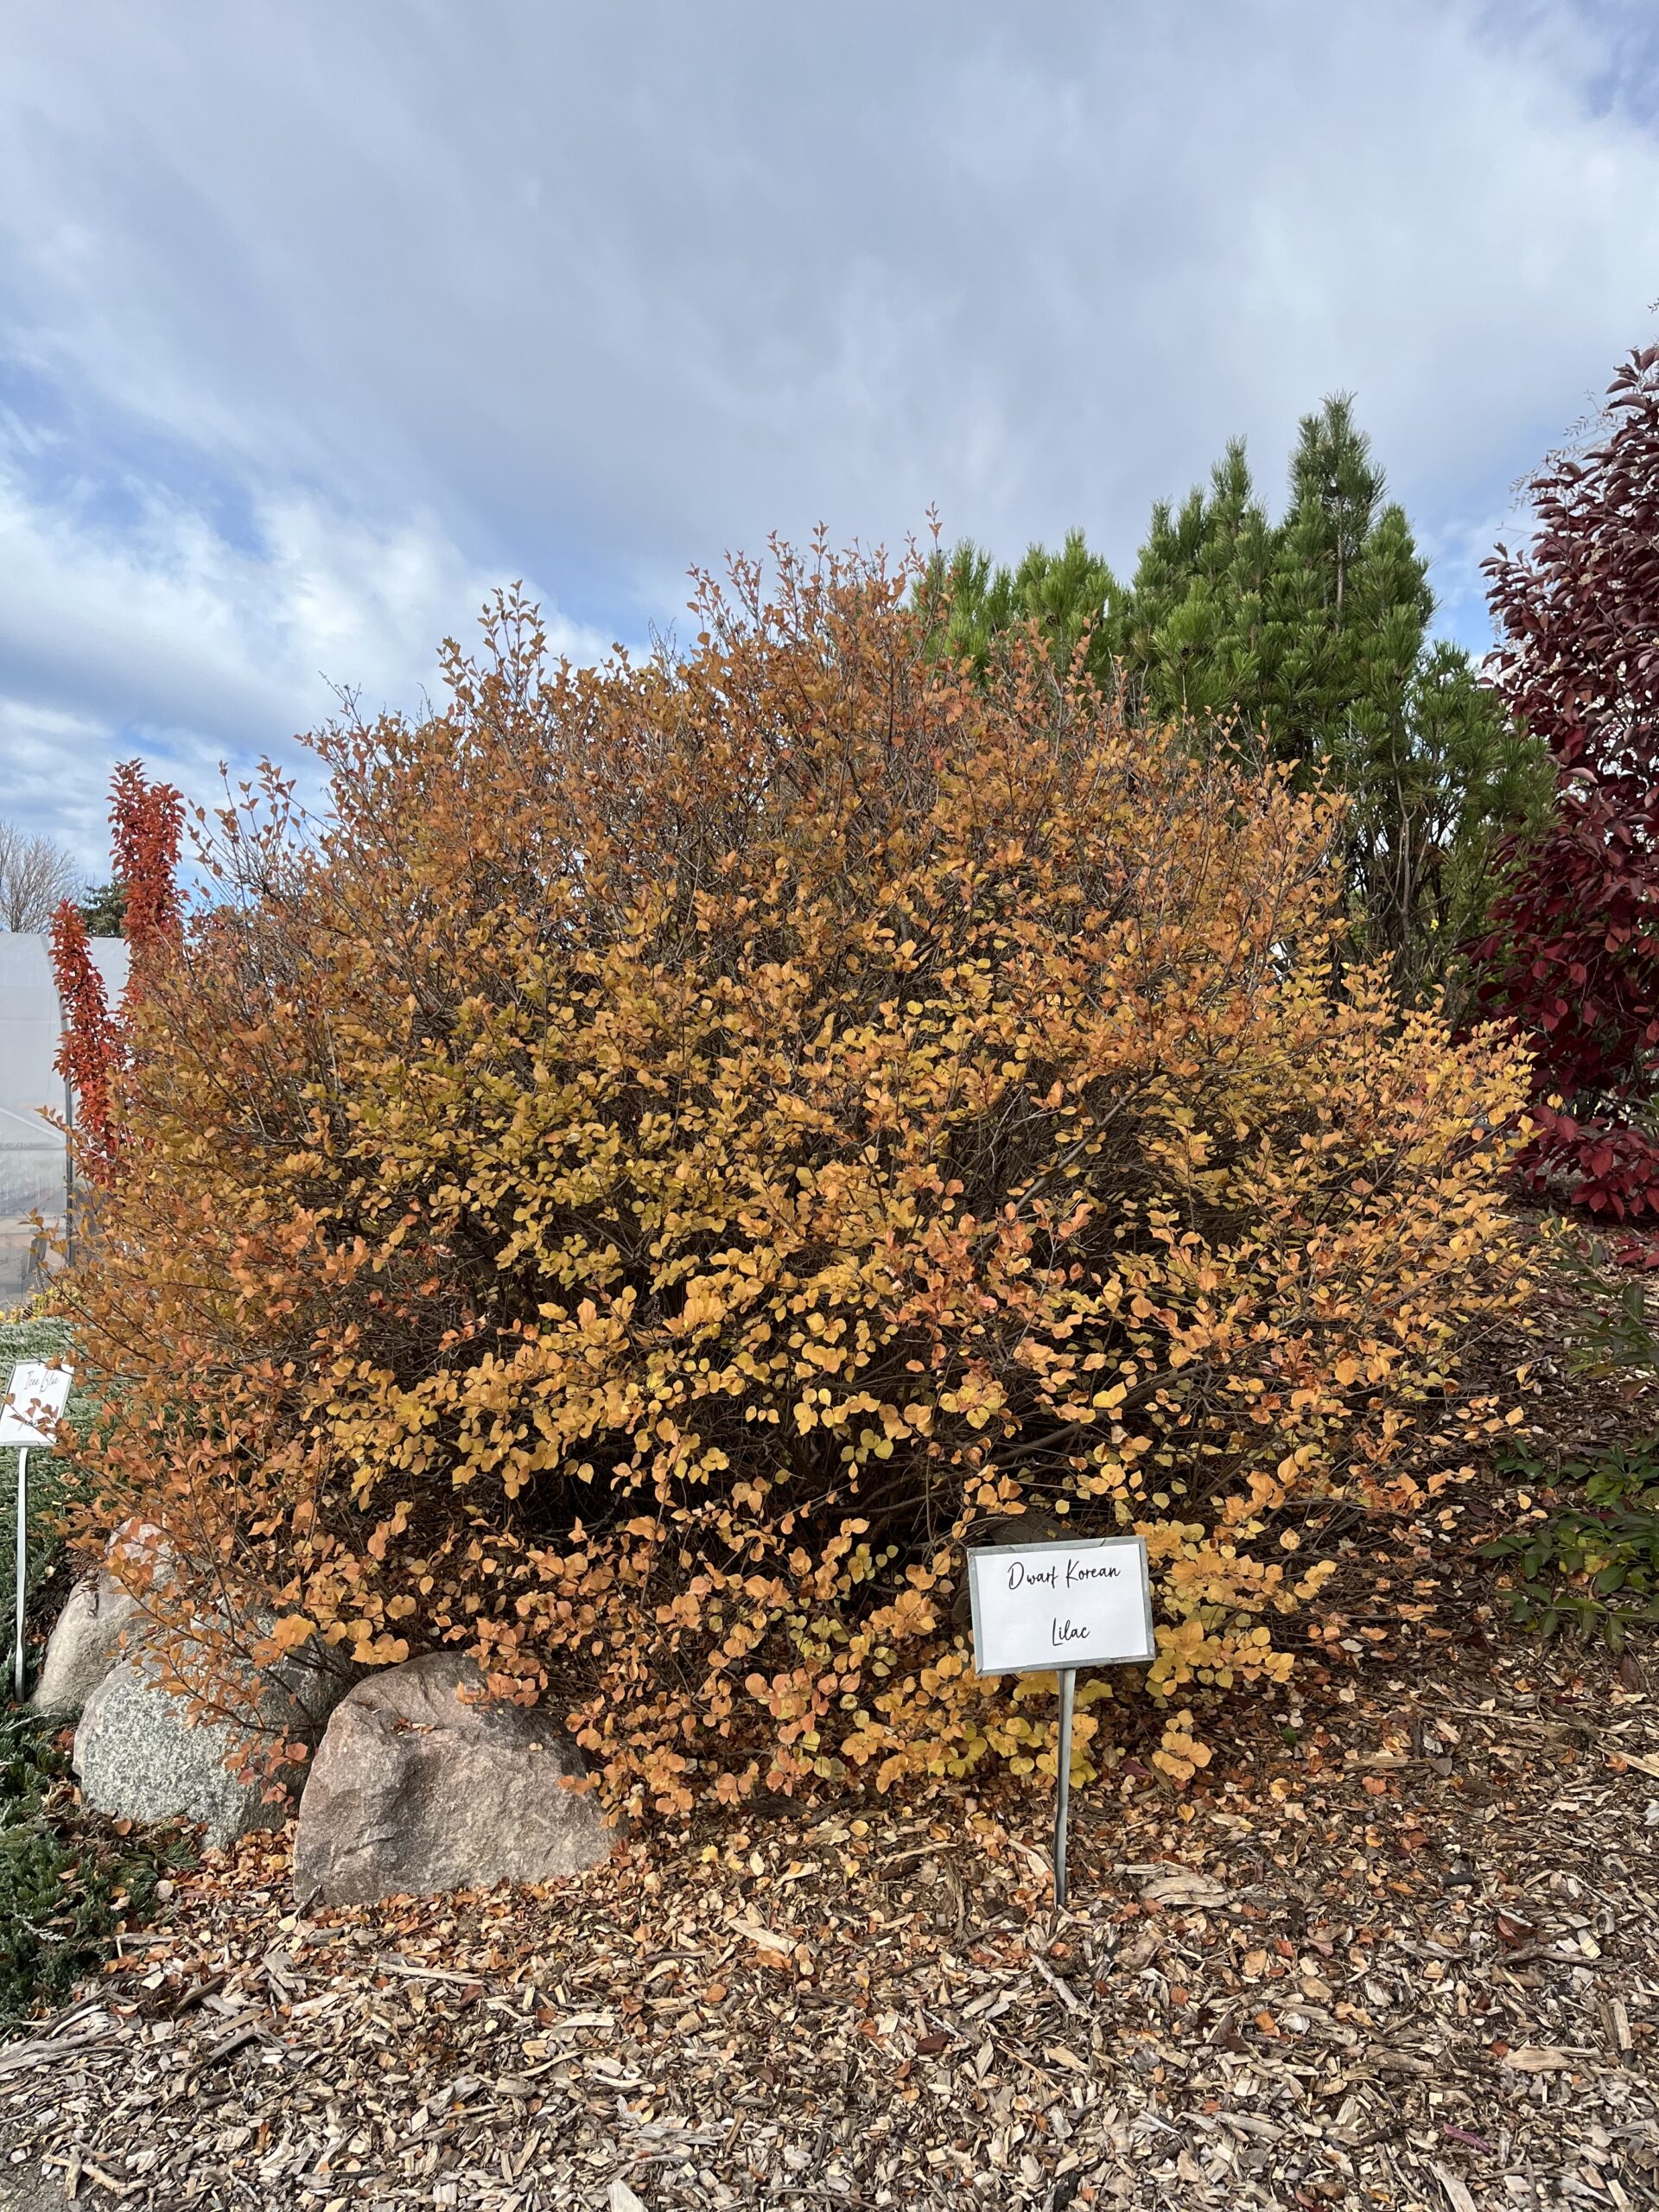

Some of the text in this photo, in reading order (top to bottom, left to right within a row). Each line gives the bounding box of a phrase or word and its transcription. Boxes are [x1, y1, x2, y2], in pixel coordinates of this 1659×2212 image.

[1007, 1558, 1121, 1590] Dwarf Korean
[1052, 1618, 1090, 1646] Lilac
